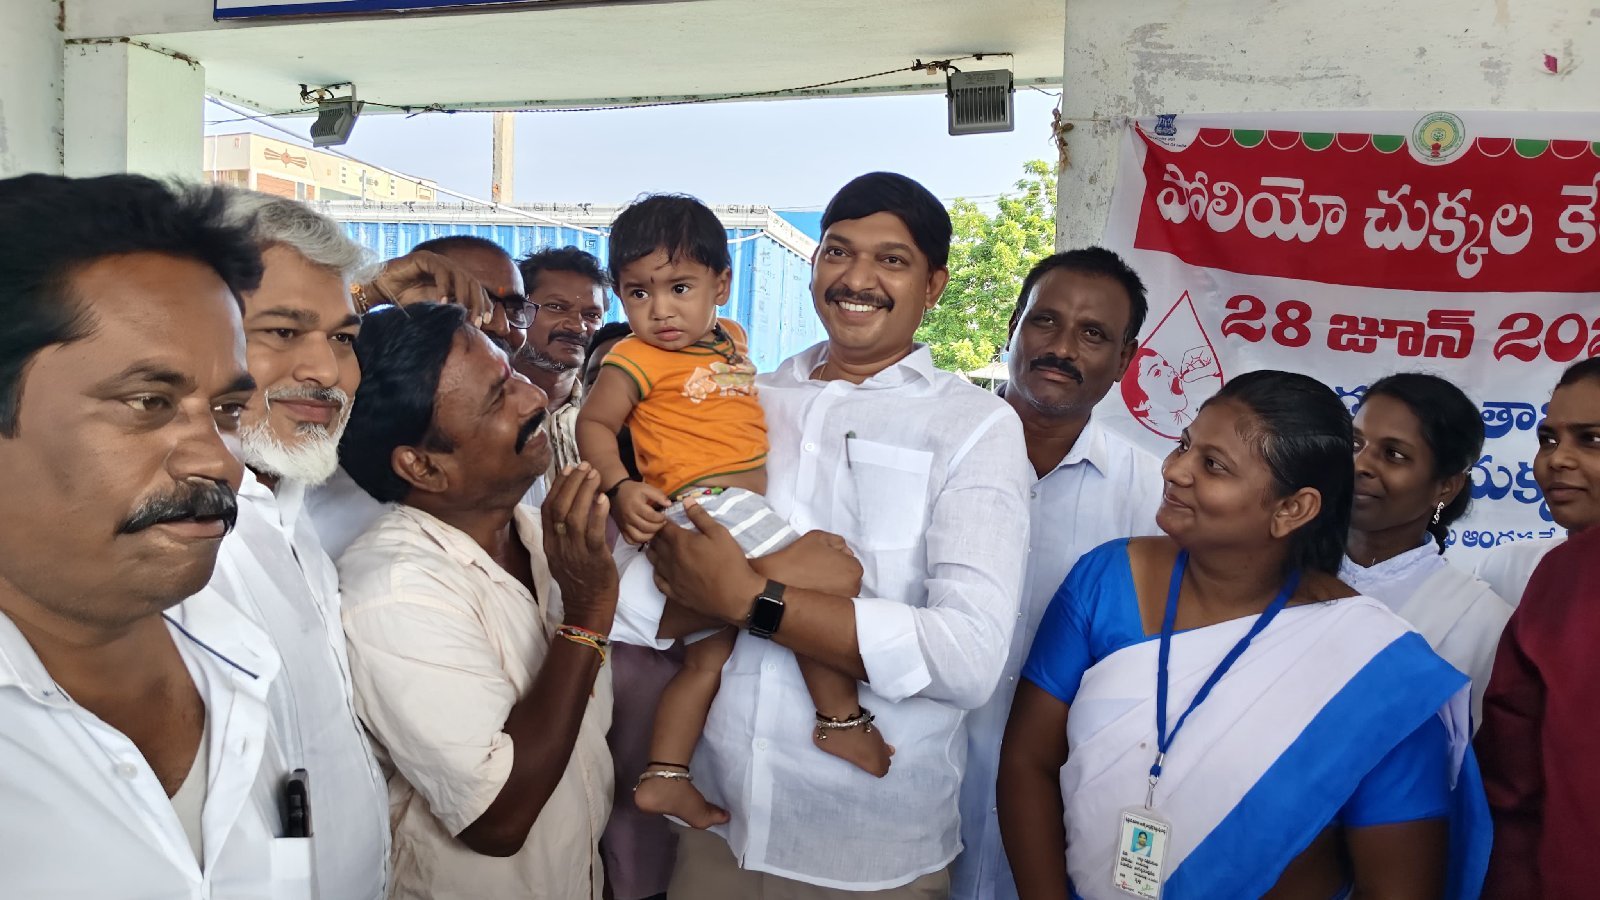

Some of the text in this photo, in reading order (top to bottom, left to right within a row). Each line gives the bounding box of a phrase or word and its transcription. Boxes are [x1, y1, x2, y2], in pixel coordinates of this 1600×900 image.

[1157, 164, 1600, 279] పోలియో చుక్కల కే
[1221, 295, 1600, 363] 28 జూన్ 20
